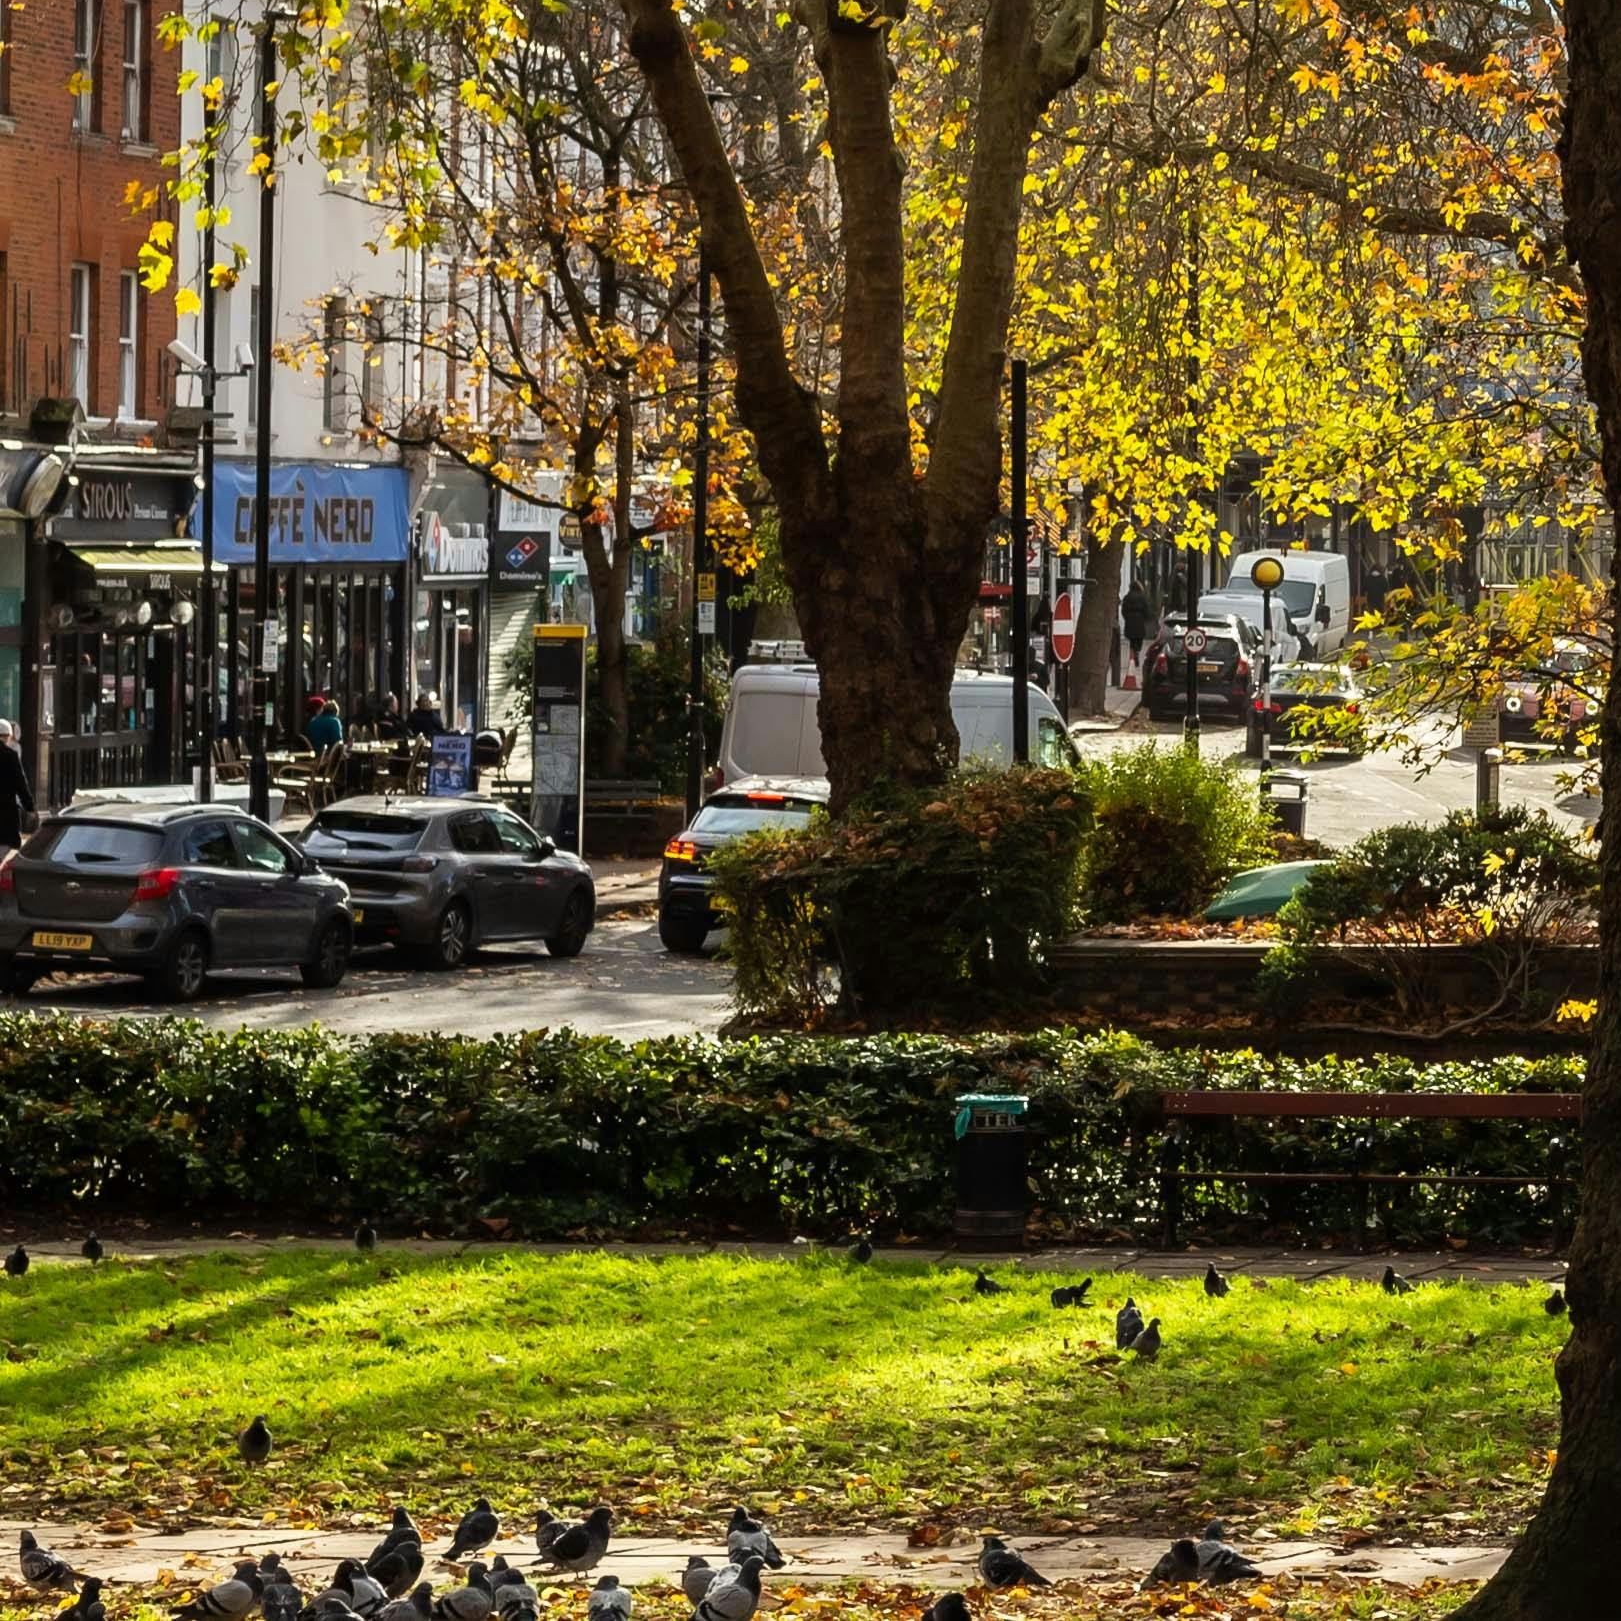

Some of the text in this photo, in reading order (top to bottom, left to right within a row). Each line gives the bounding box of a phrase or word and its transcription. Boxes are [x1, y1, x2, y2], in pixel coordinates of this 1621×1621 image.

[82, 482, 132, 520] SIROUS
[313, 496, 374, 544] NERO
[1187, 635, 1204, 647] 20
